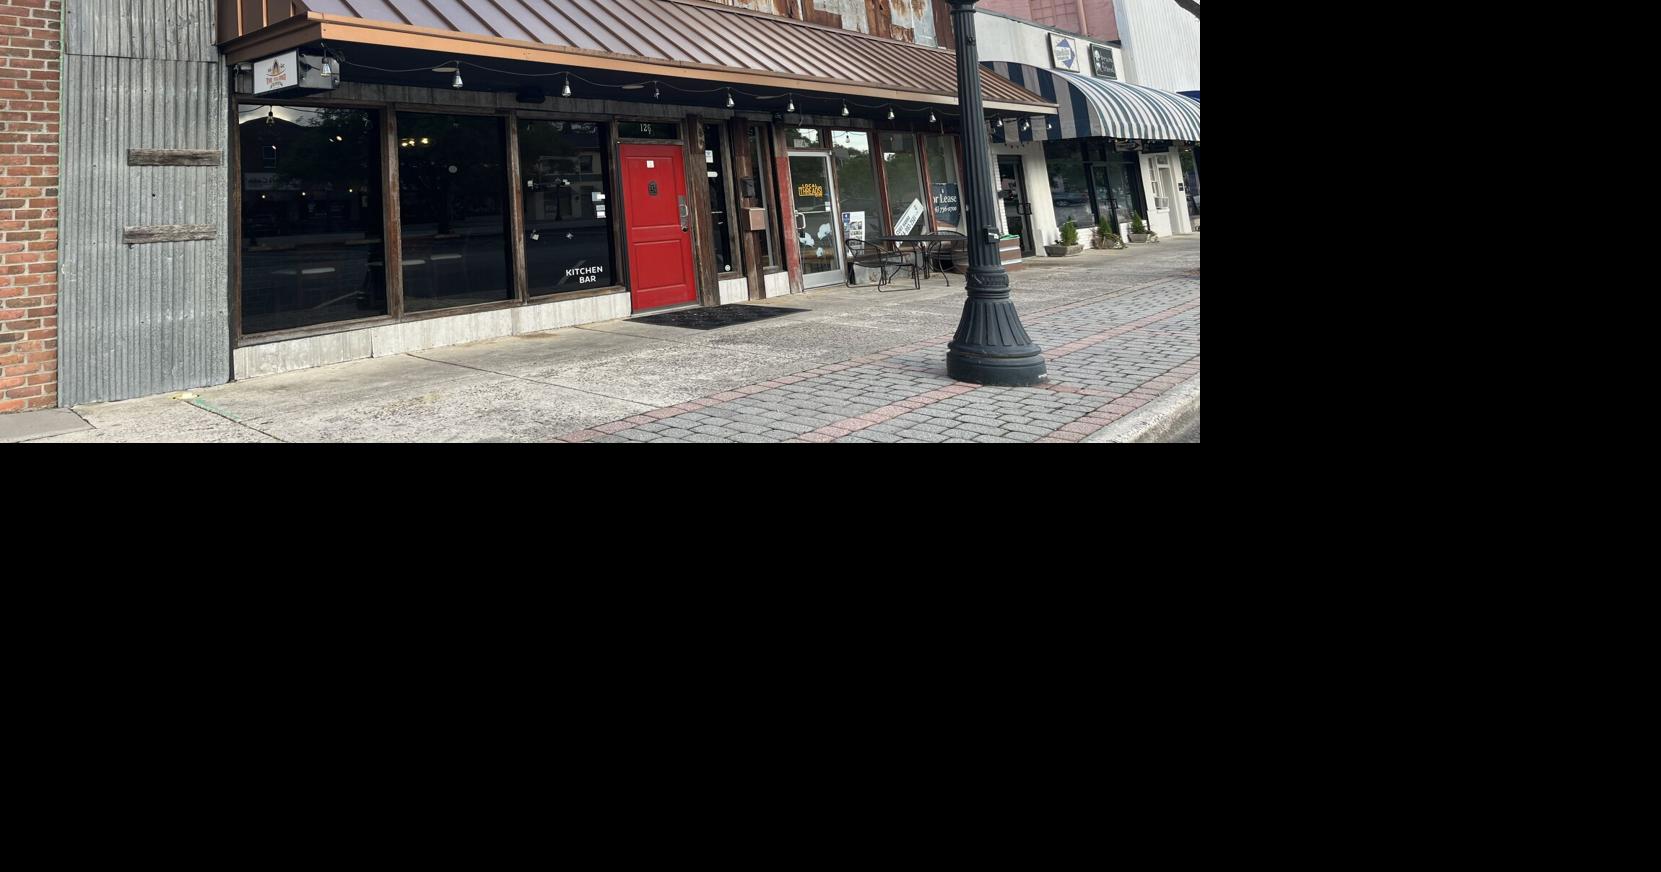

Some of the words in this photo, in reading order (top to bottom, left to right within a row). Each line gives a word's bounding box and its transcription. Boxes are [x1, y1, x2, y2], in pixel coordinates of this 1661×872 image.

[939, 193, 957, 203] Lease
[565, 266, 603, 277] KITCHEN
[579, 275, 597, 284] BAR
